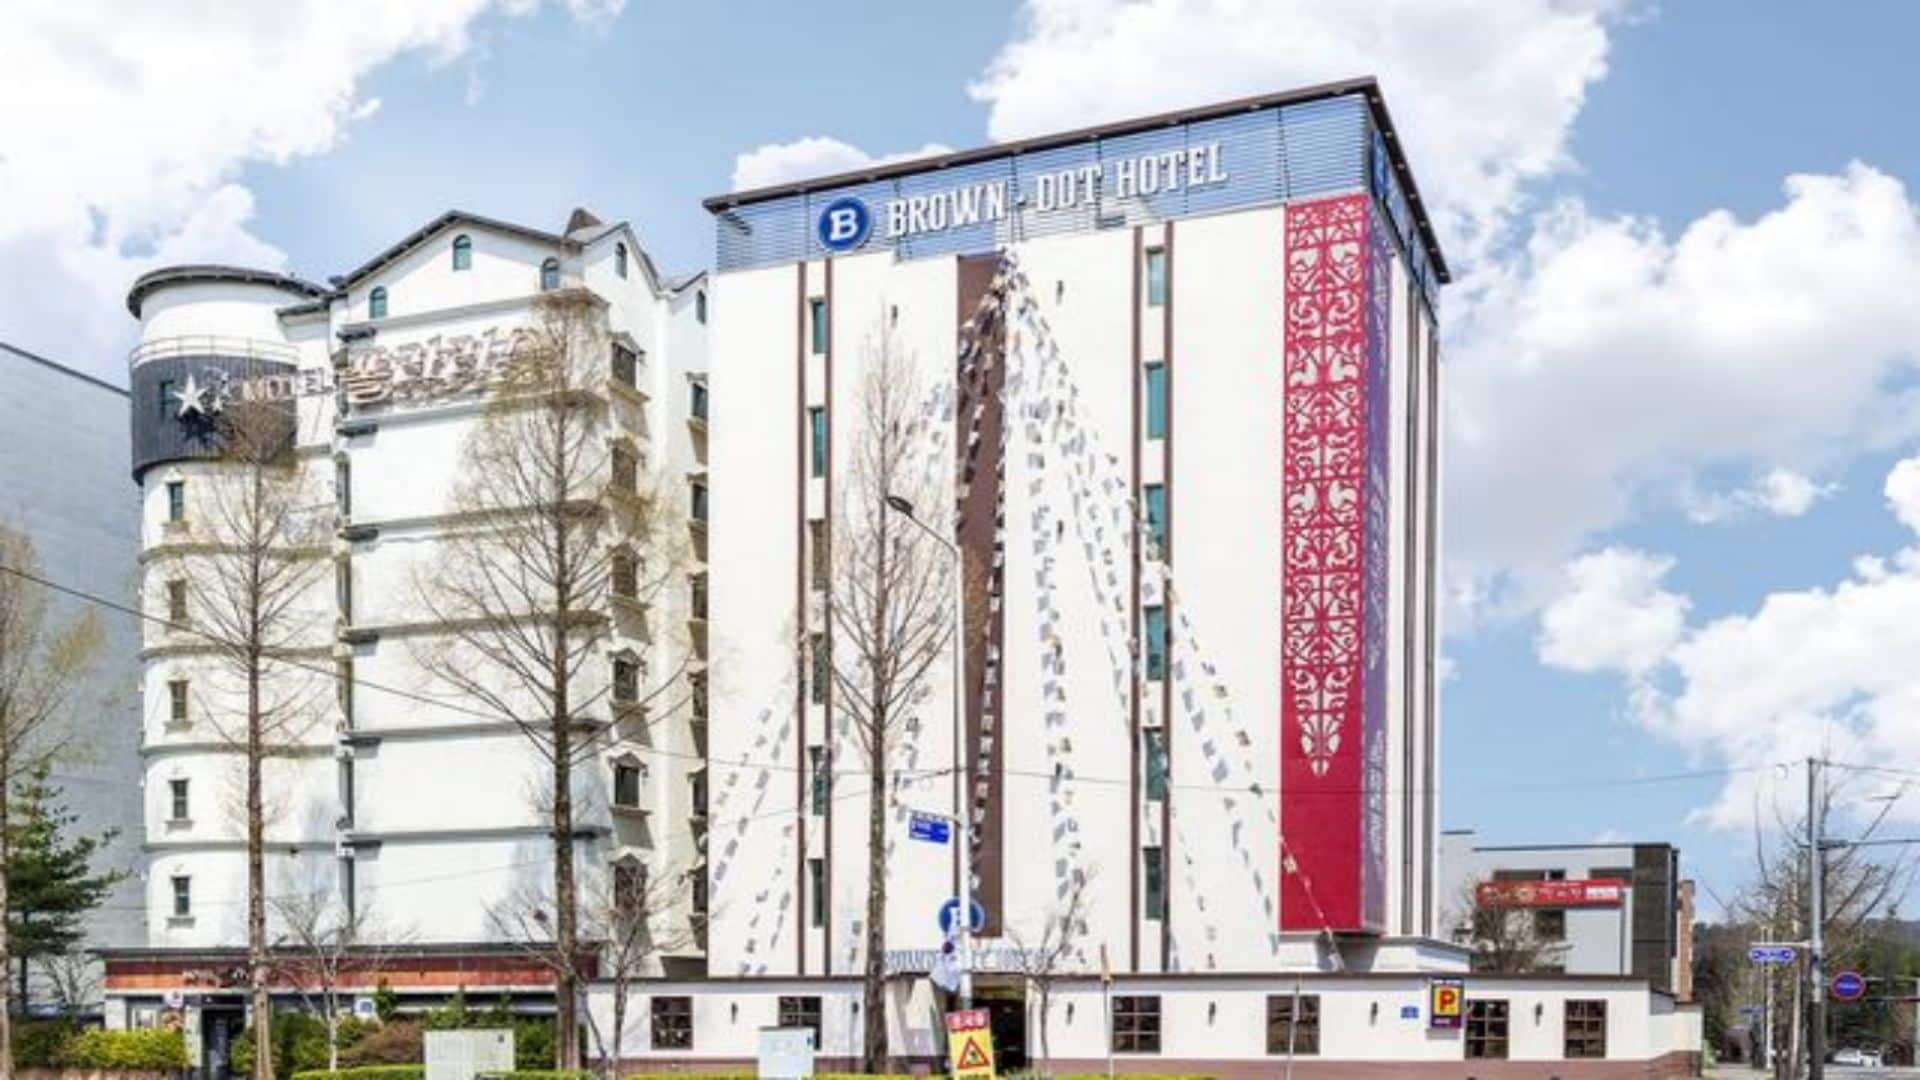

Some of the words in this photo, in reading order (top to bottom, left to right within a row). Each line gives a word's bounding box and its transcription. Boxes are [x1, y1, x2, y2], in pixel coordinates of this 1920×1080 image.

[886, 181, 1008, 238] BROWN
[1036, 164, 1103, 211] DOT
[1116, 139, 1228, 199] HOTEL
[829, 208, 858, 241] B
[241, 367, 337, 400] MOTEL
[1439, 990, 1456, 1012] P
